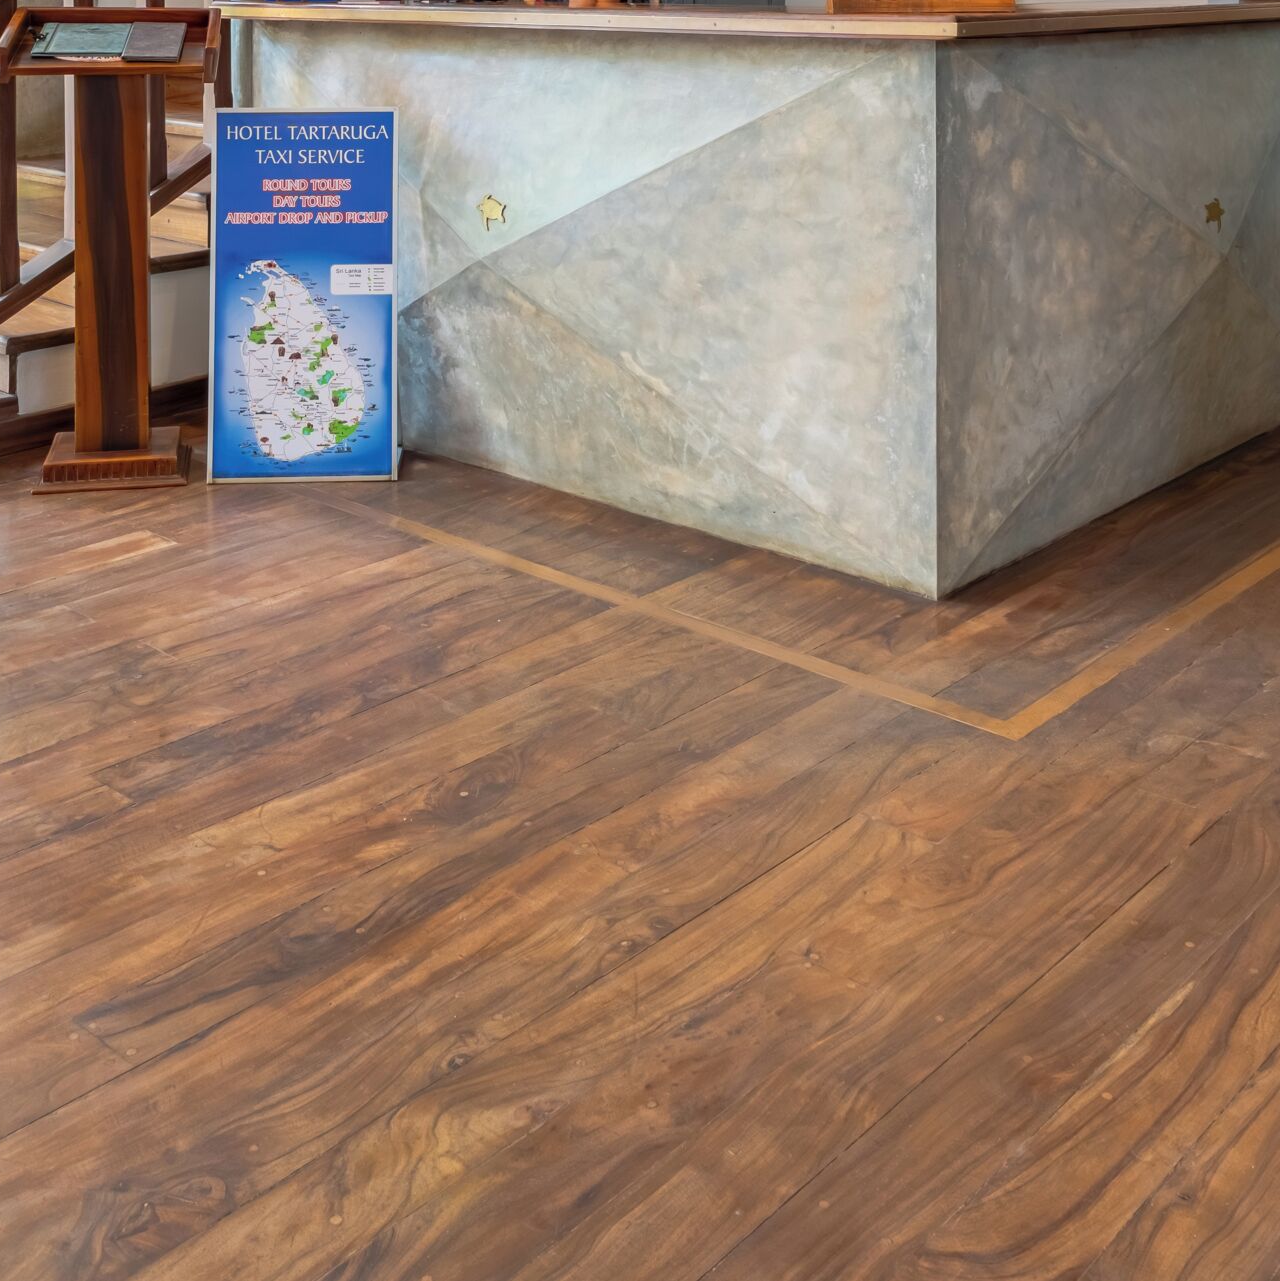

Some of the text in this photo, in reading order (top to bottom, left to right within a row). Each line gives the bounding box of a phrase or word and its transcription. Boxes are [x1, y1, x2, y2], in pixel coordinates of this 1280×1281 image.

[226, 125, 389, 141] HOTEL TARTARUGA
[255, 149, 366, 164] TAXI SERVICE
[262, 178, 352, 192] ROUND TOURS
[272, 195, 341, 208] DAY TOURS
[224, 211, 389, 225] AIRPORT DROP AND PICKUP
